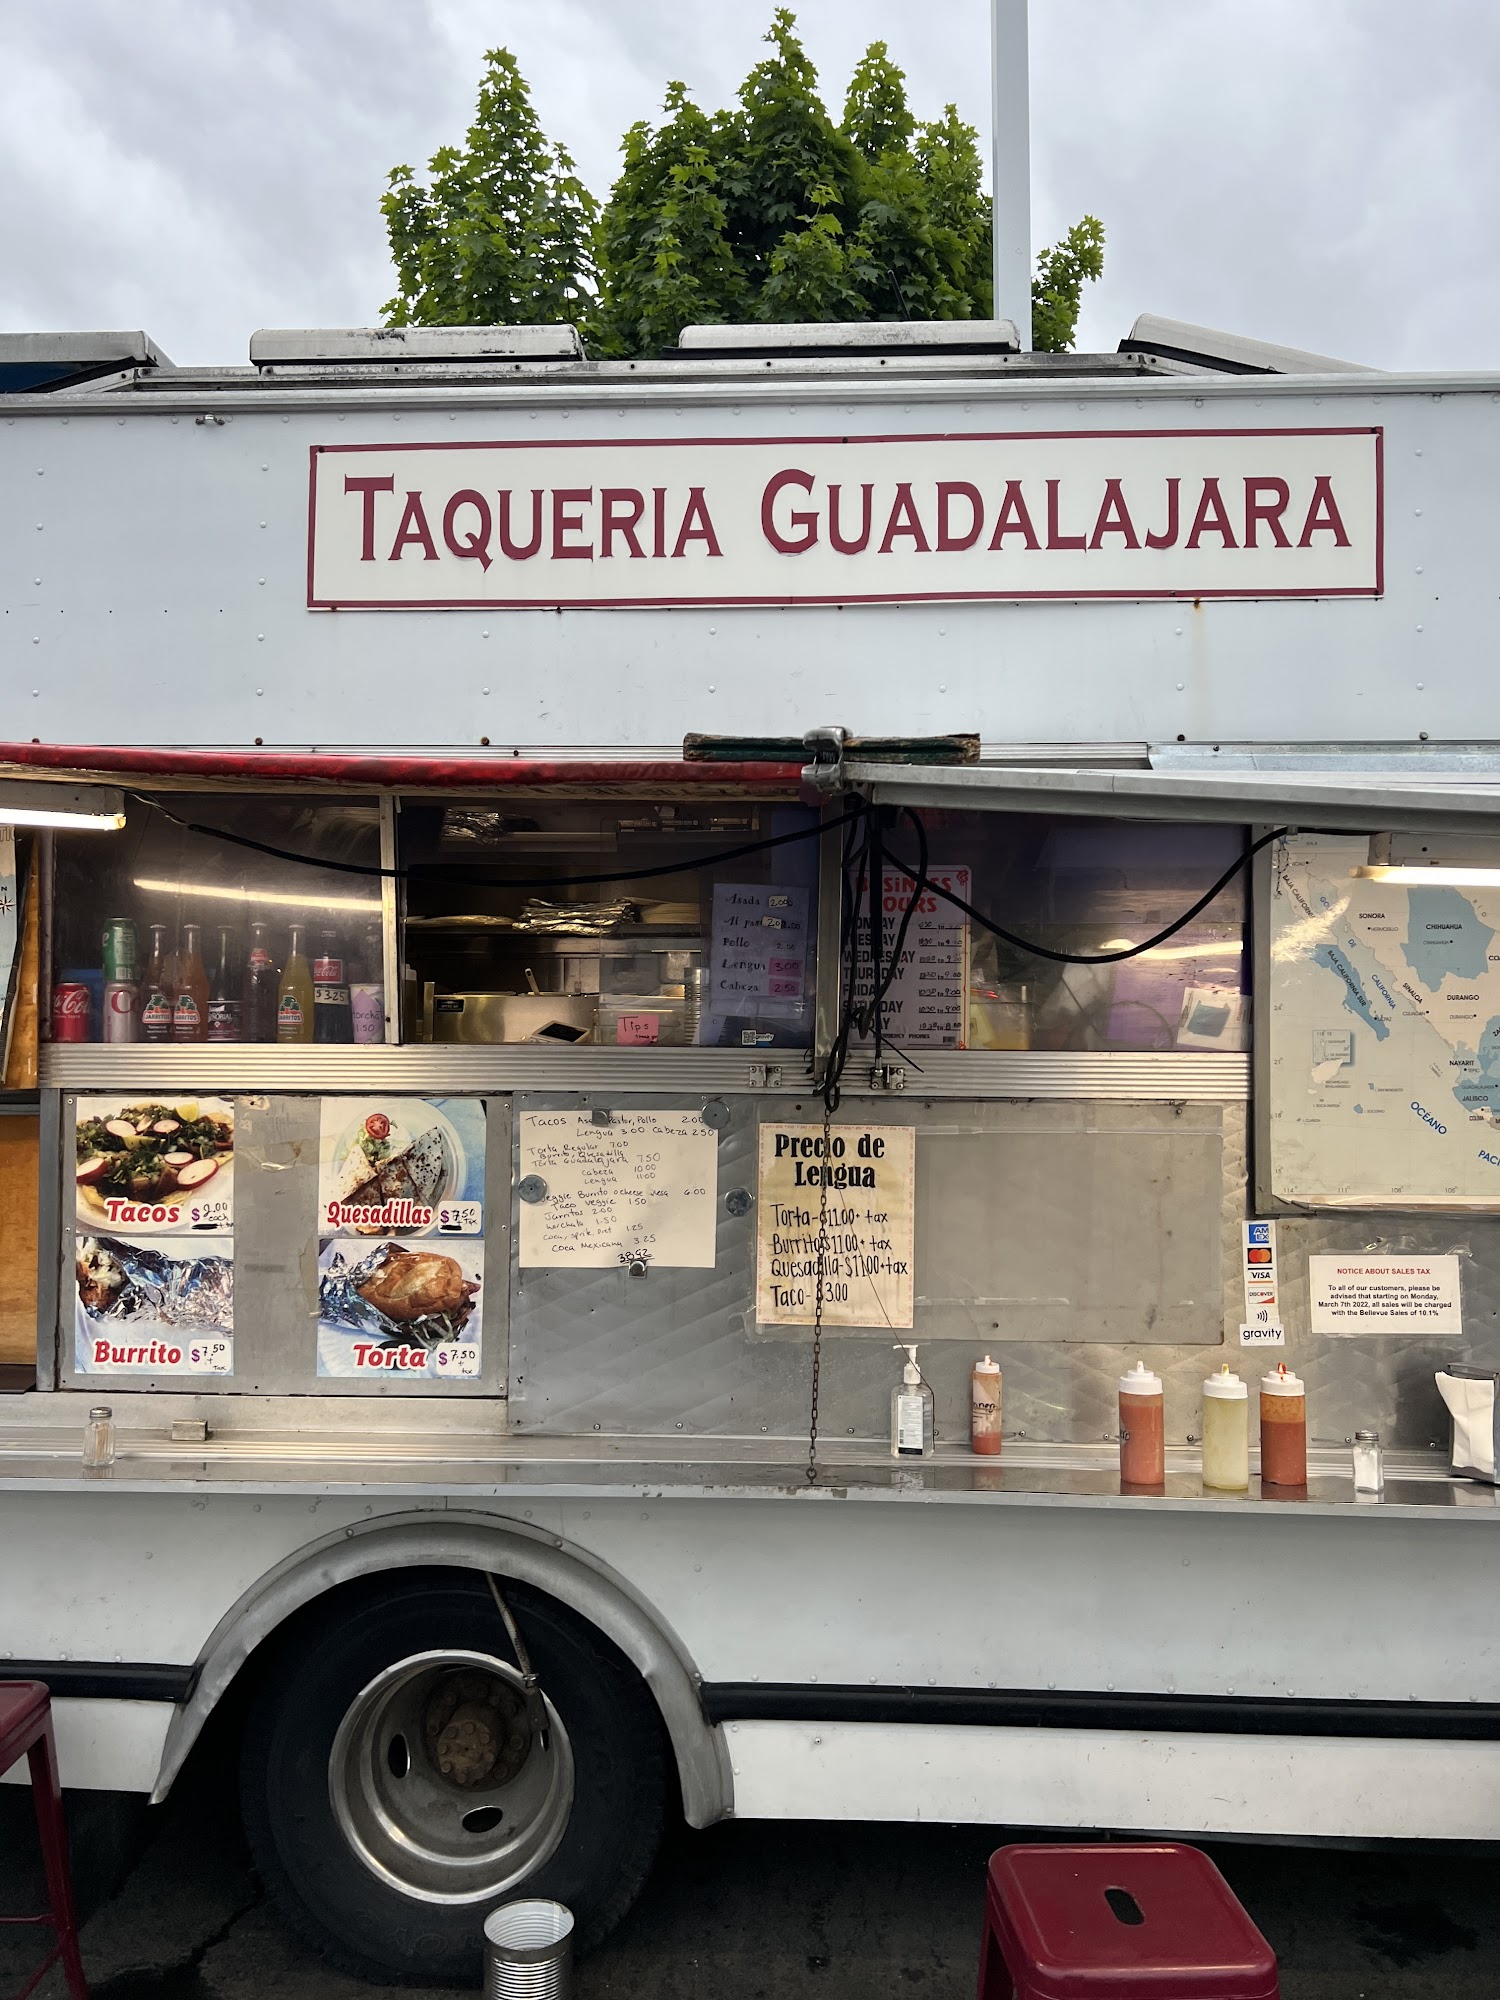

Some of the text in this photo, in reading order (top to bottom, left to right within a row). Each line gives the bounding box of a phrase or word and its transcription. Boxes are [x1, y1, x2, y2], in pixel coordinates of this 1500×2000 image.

[345, 468, 1353, 573] TAQUERIA GUADALAJARA
[874, 896, 937, 913] OURS
[1282, 875, 1294, 890] BAJA
[1292, 888, 1316, 919] CALIFORNI
[1327, 949, 1367, 1007] BAJA CALIFORNIA SUR
[1348, 938, 1397, 1010] DE CALIFORNIA
[1402, 982, 1423, 1004] SINALOA
[618, 1015, 649, 1034] Tips
[525, 1115, 567, 1126] Tacos
[637, 1115, 657, 1124] Pollo
[1410, 1101, 1448, 1135] OCÉANO
[576, 1128, 614, 1140] Lengua
[526, 1143, 558, 1156] Torta
[563, 1143, 598, 1152] Regular
[774, 1133, 885, 1158] Precio de
[794, 1161, 876, 1190] Lengua
[577, 1187, 608, 1198] Burrito
[683, 1188, 706, 1196] 6.00
[107, 1200, 228, 1222] Tacos $ 2.00
[327, 1201, 450, 1228] Quesadillas $
[544, 1208, 584, 1220] Jarritos
[550, 1202, 576, 1211] Taco
[595, 1215, 617, 1224] 1.50
[865, 1209, 888, 1224] tax
[633, 1234, 656, 1244] 3.25
[869, 1234, 892, 1252] tax
[1251, 1271, 1270, 1279] VISA
[1242, 1328, 1282, 1340] gravity
[94, 1340, 226, 1364] Burrito $ 7.50
[353, 1344, 476, 1368] Torta $ 7.50
